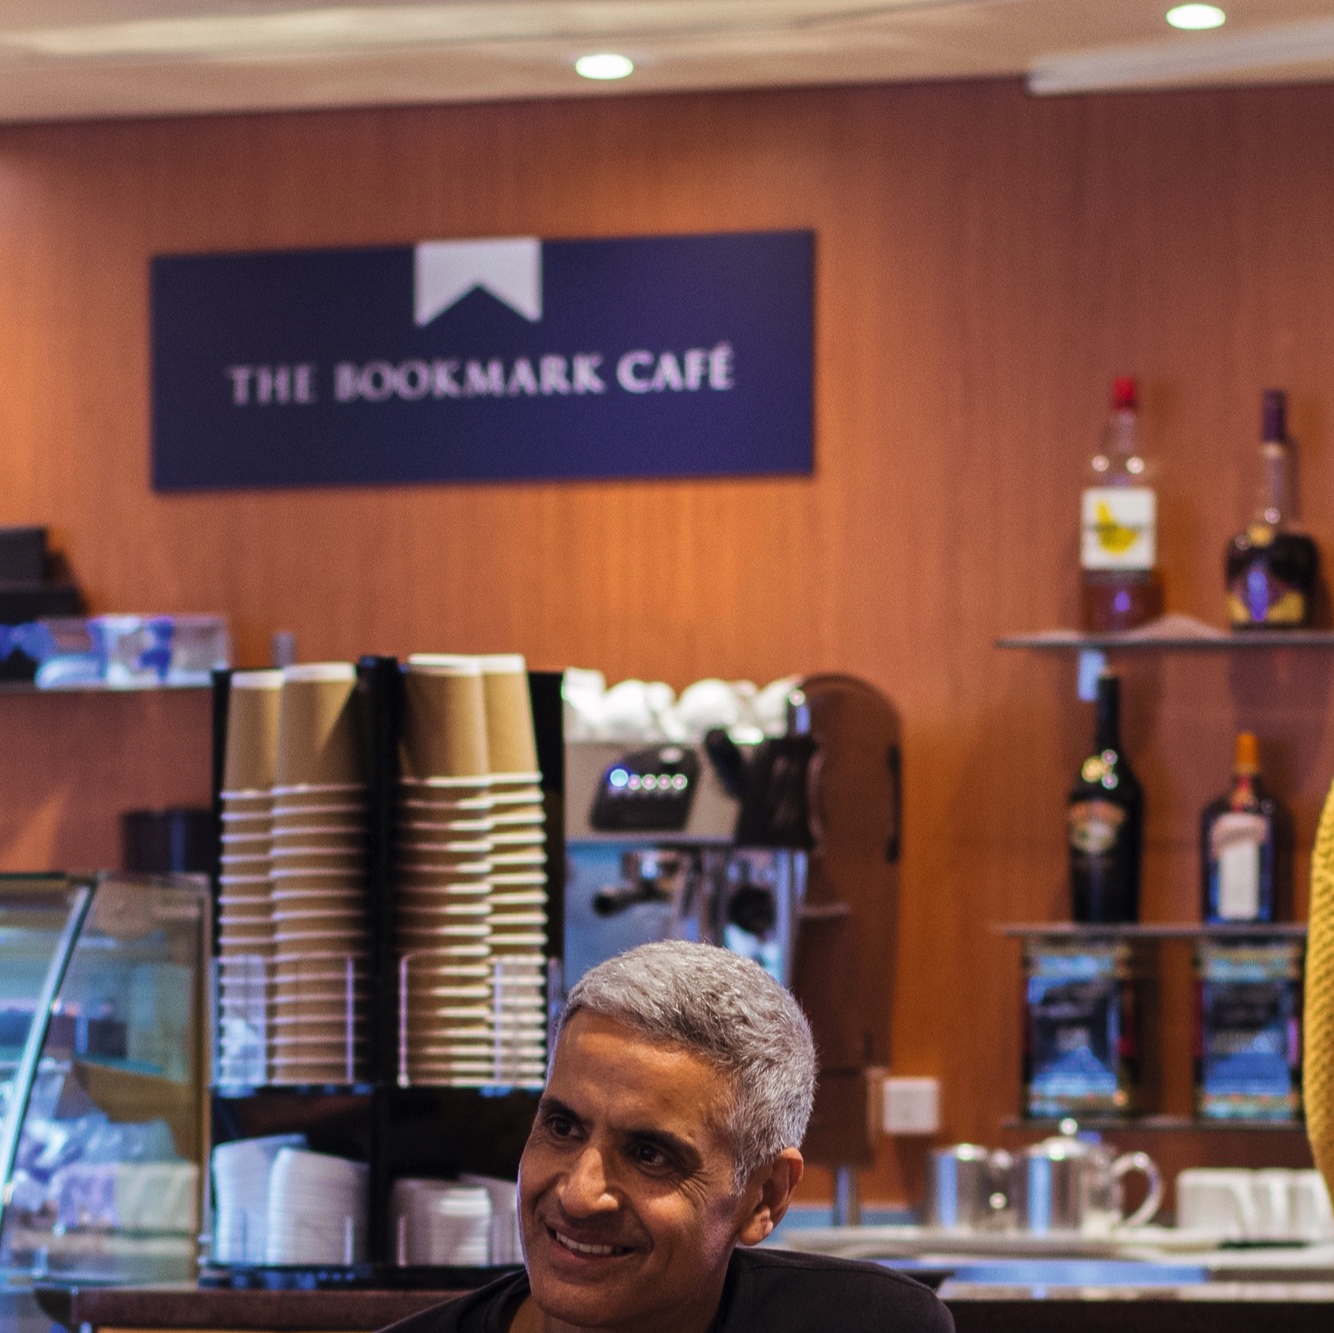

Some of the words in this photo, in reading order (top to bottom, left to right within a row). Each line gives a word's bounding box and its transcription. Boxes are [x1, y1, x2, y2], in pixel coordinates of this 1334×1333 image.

[228, 364, 313, 404] THE
[333, 352, 606, 401] BOOKMARK
[615, 341, 734, 394] CAFÉ
